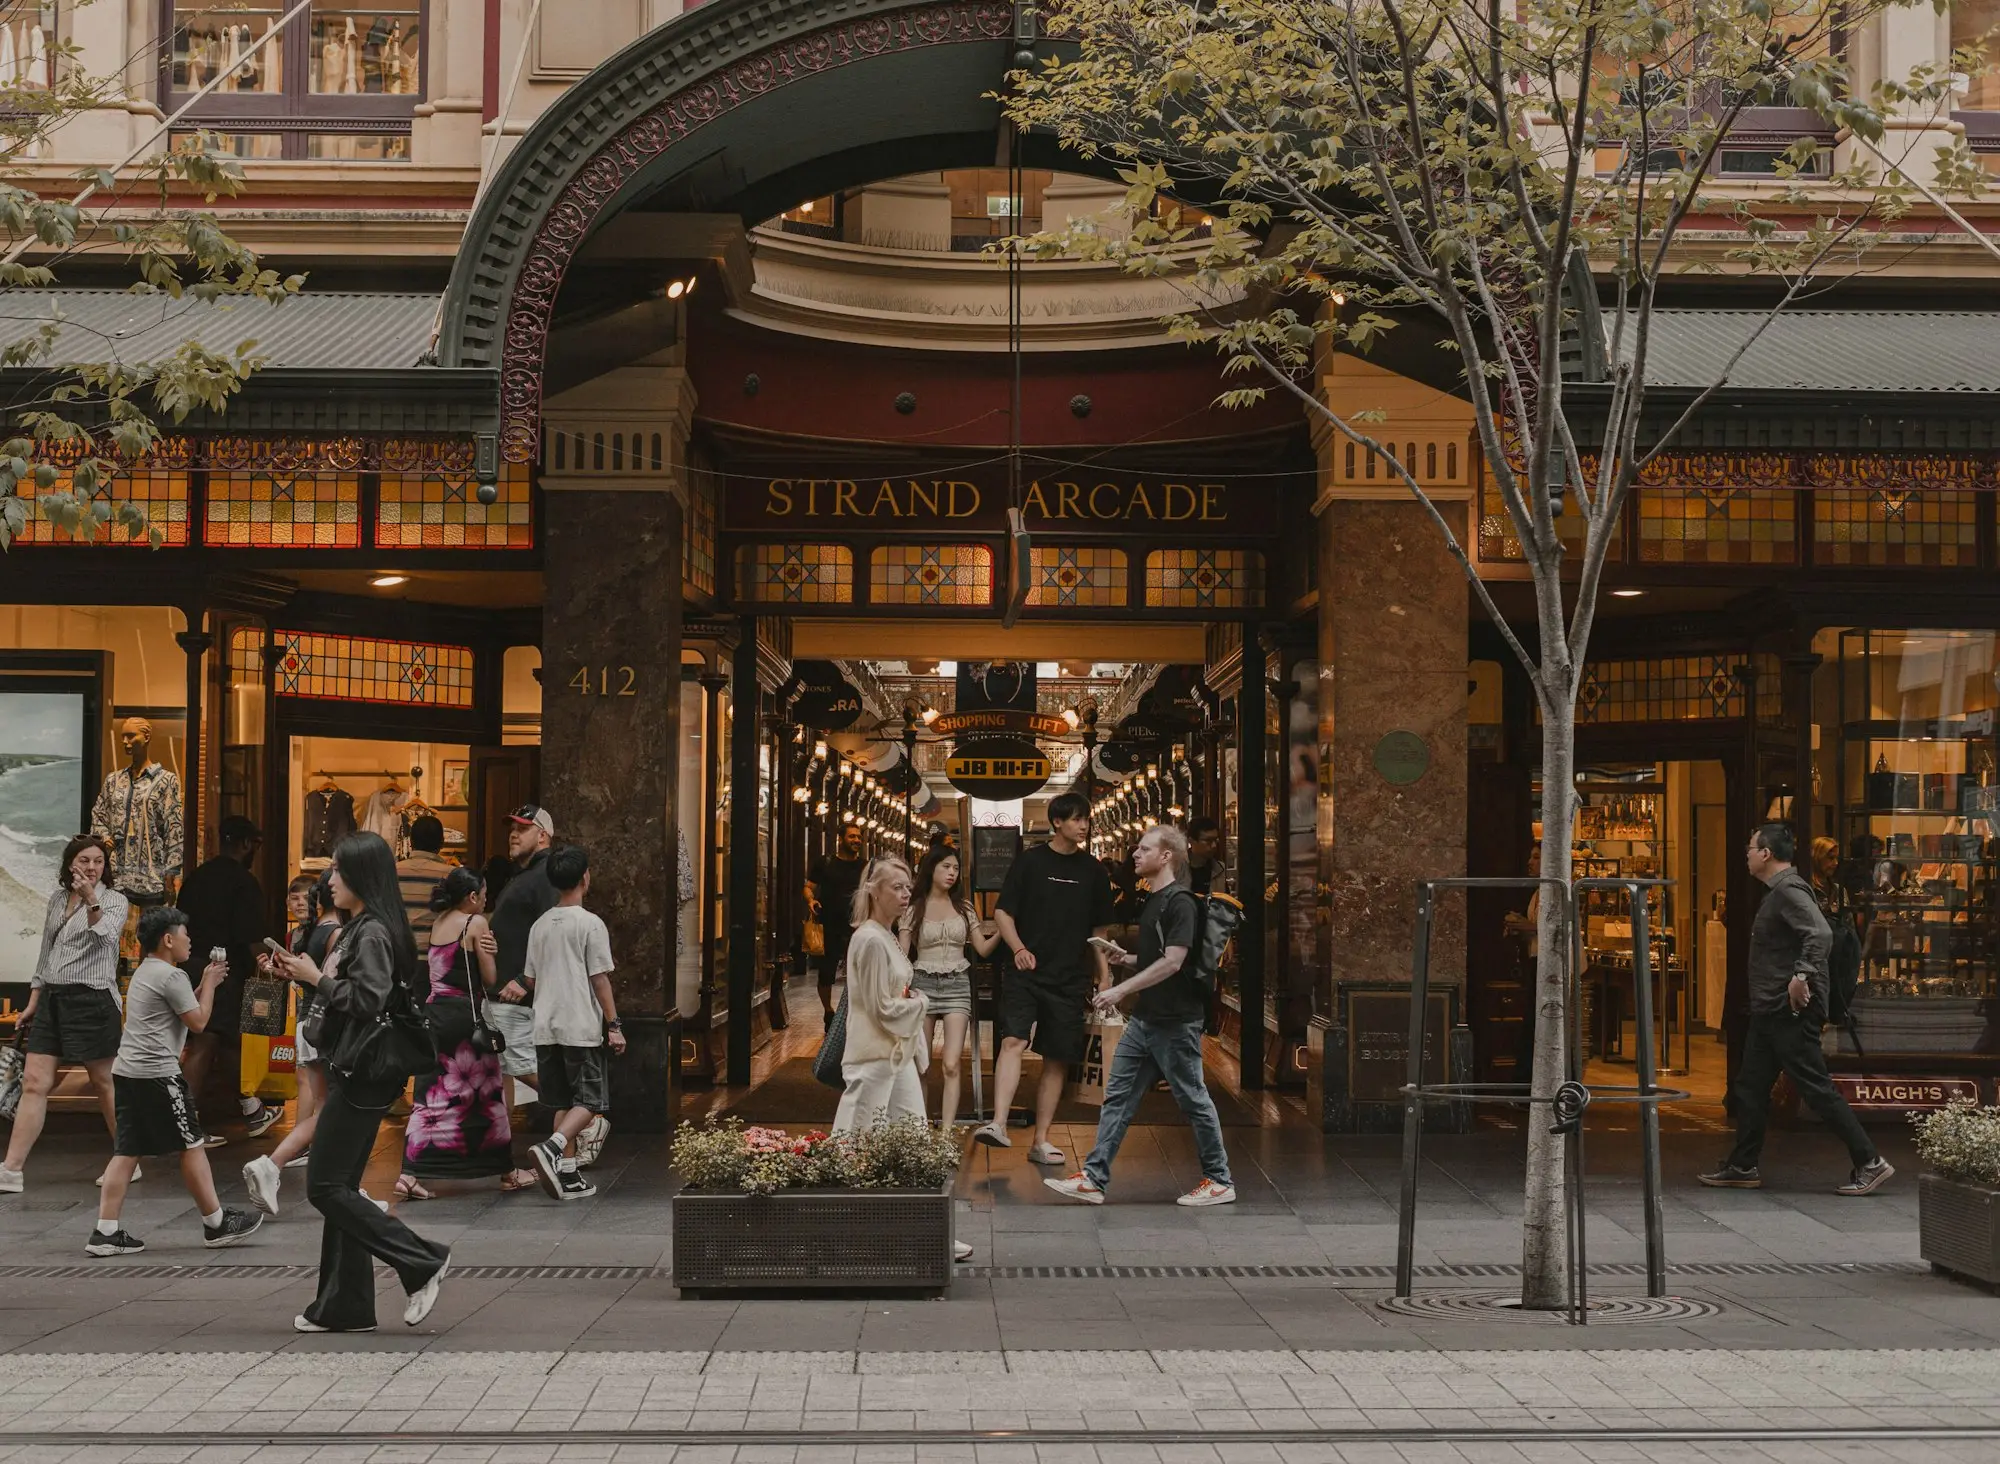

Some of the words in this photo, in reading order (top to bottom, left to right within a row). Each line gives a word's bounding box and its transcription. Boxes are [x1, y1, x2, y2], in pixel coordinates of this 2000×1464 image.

[765, 479, 981, 518] STRAND
[1021, 480, 1228, 521] ARCADE
[568, 665, 638, 696] 412
[937, 713, 1007, 731] SHOPPING
[1028, 716, 1062, 733] LIFT
[955, 760, 987, 775] JB
[993, 760, 1043, 776] HI-FI
[271, 1046, 295, 1061] LEGO
[1360, 1049, 1432, 1061] BOOSTR
[1855, 1085, 1943, 1101] HAIGH'S
